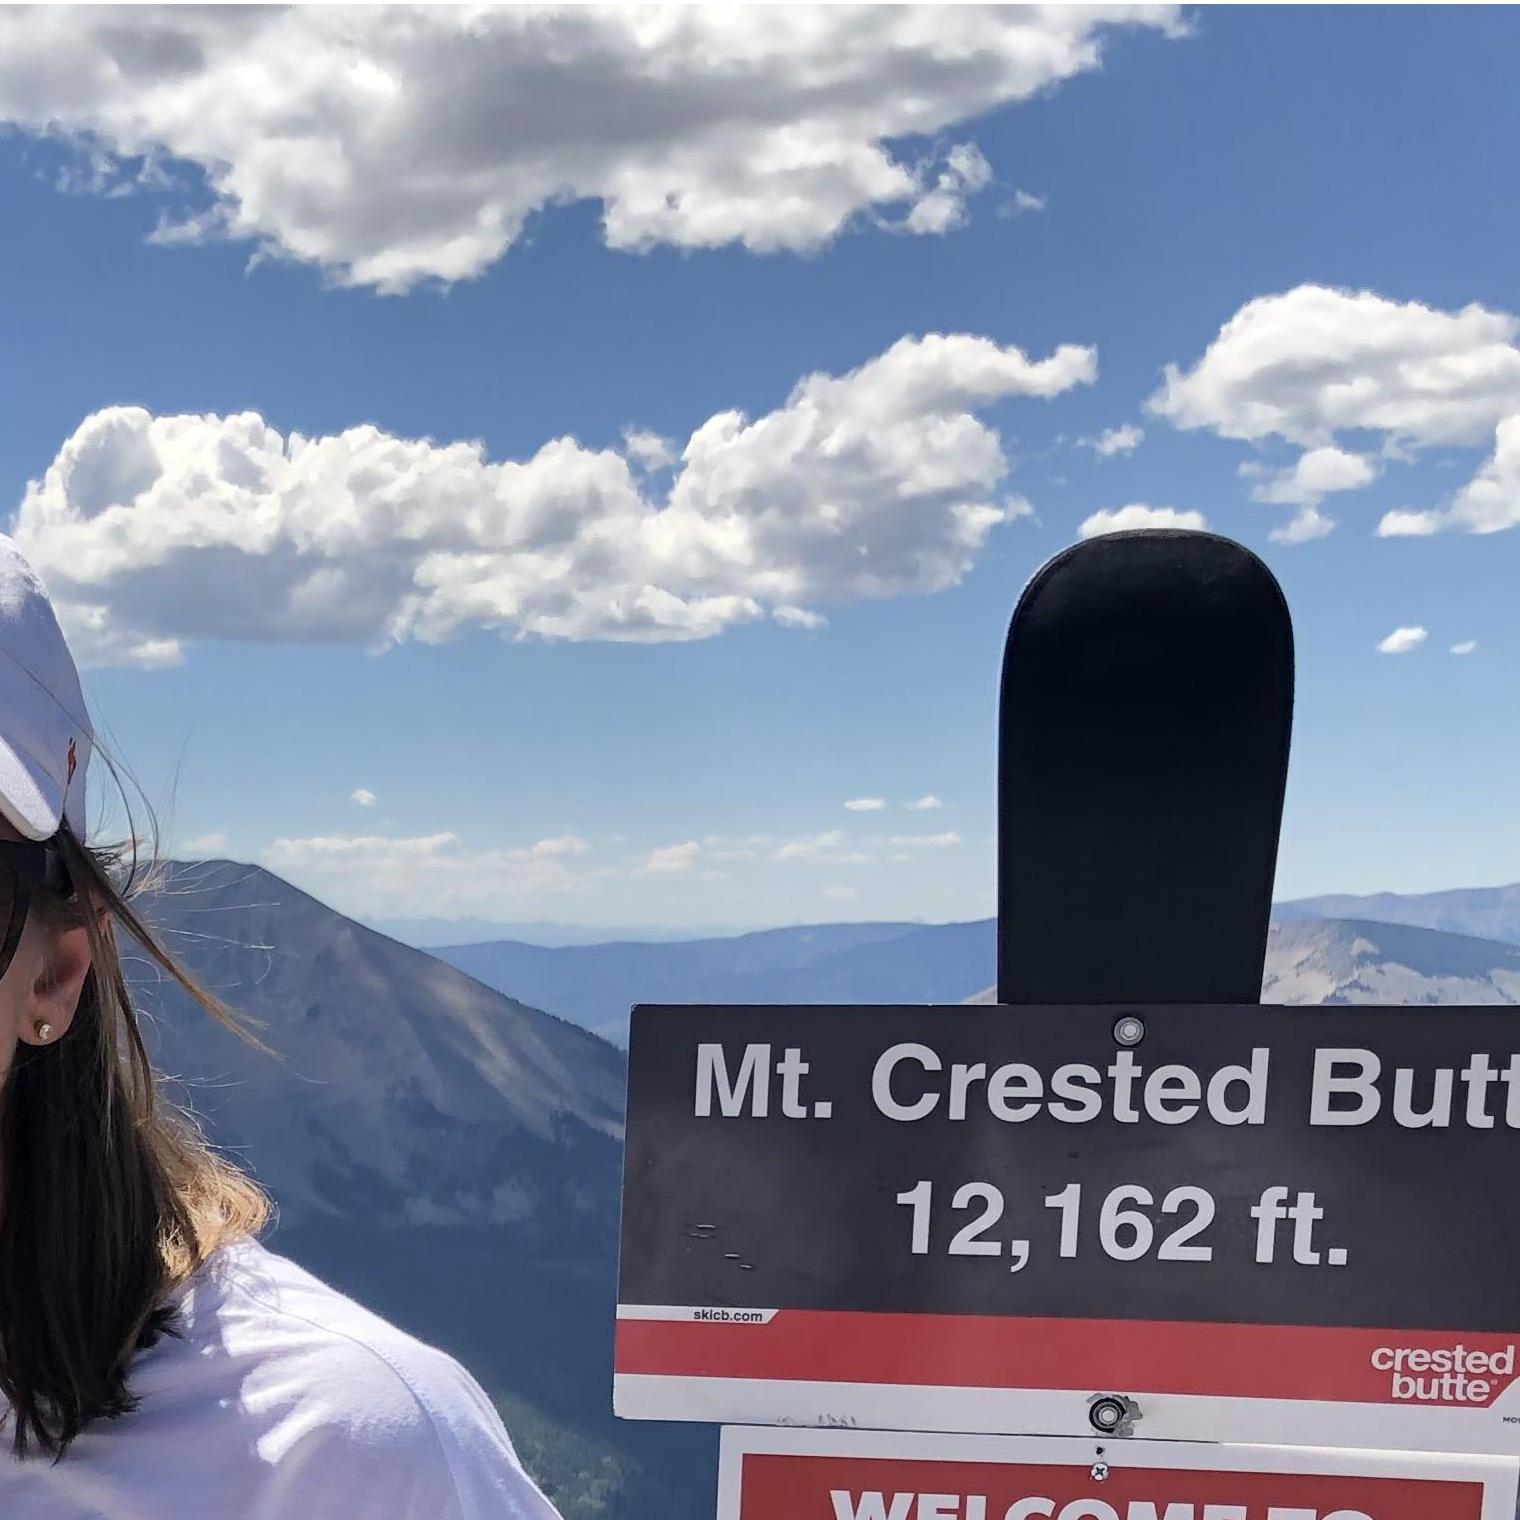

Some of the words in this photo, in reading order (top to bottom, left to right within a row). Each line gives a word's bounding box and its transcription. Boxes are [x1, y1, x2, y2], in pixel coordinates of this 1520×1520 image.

[696, 1043, 832, 1118] Mt.
[872, 1042, 1270, 1125] Crested
[896, 1181, 1215, 1273] 12,162
[1251, 1187, 1348, 1265] ft.
[693, 1308, 763, 1322] skicb.com
[1371, 1344, 1516, 1375] crested
[1392, 1372, 1491, 1402] butte
